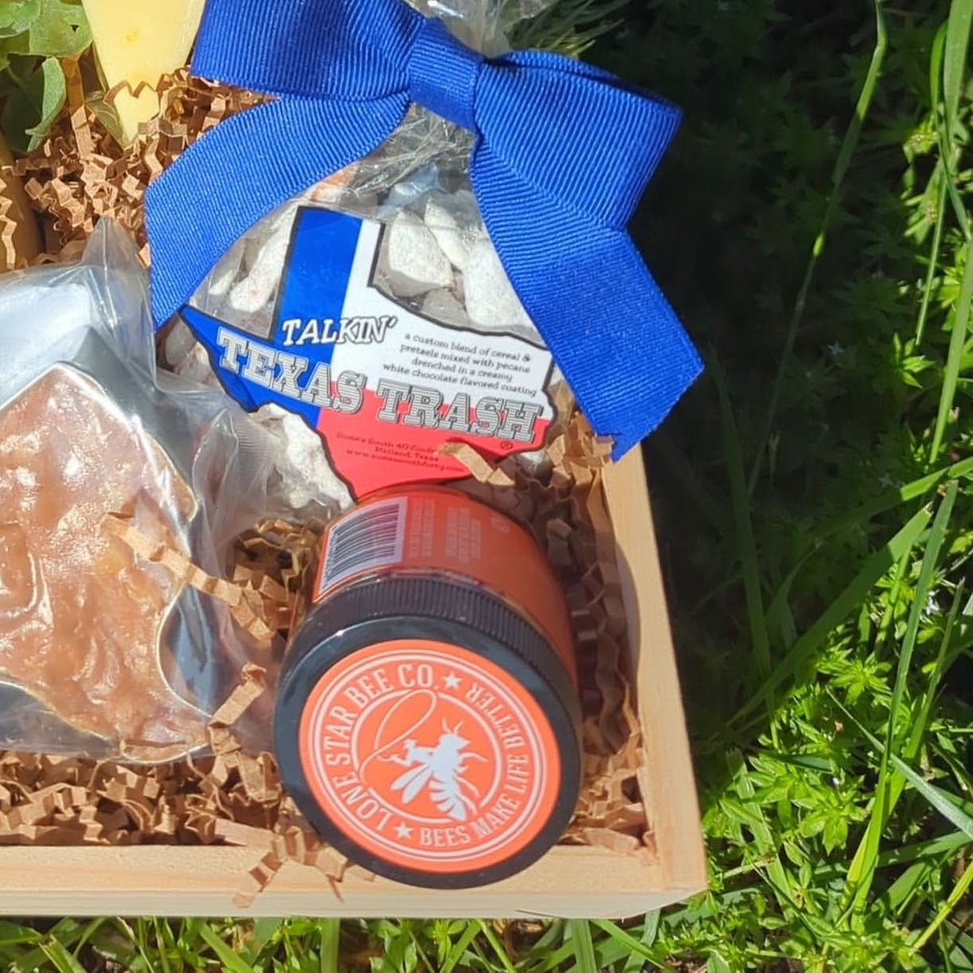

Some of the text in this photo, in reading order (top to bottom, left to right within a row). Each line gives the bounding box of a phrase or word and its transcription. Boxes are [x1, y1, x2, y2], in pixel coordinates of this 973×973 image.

[282, 315, 398, 346] TALKIN'
[413, 334, 449, 349] custom
[450, 340, 477, 354] blend
[479, 347, 491, 357] of
[491, 349, 521, 362] cereal
[440, 350, 470, 364] mixed
[472, 356, 495, 368] with
[496, 360, 531, 374] pecans
[216, 326, 544, 444] TEXAS TRASH
[383, 363, 537, 398] white chocolate flavored coating
[411, 357, 456, 373] drenched
[458, 365, 468, 374] in
[477, 369, 513, 383] creamy
[323, 662, 440, 832] LONE STAR BEE CO.
[419, 682, 530, 848] BEES MAKE LIFE BETTER
